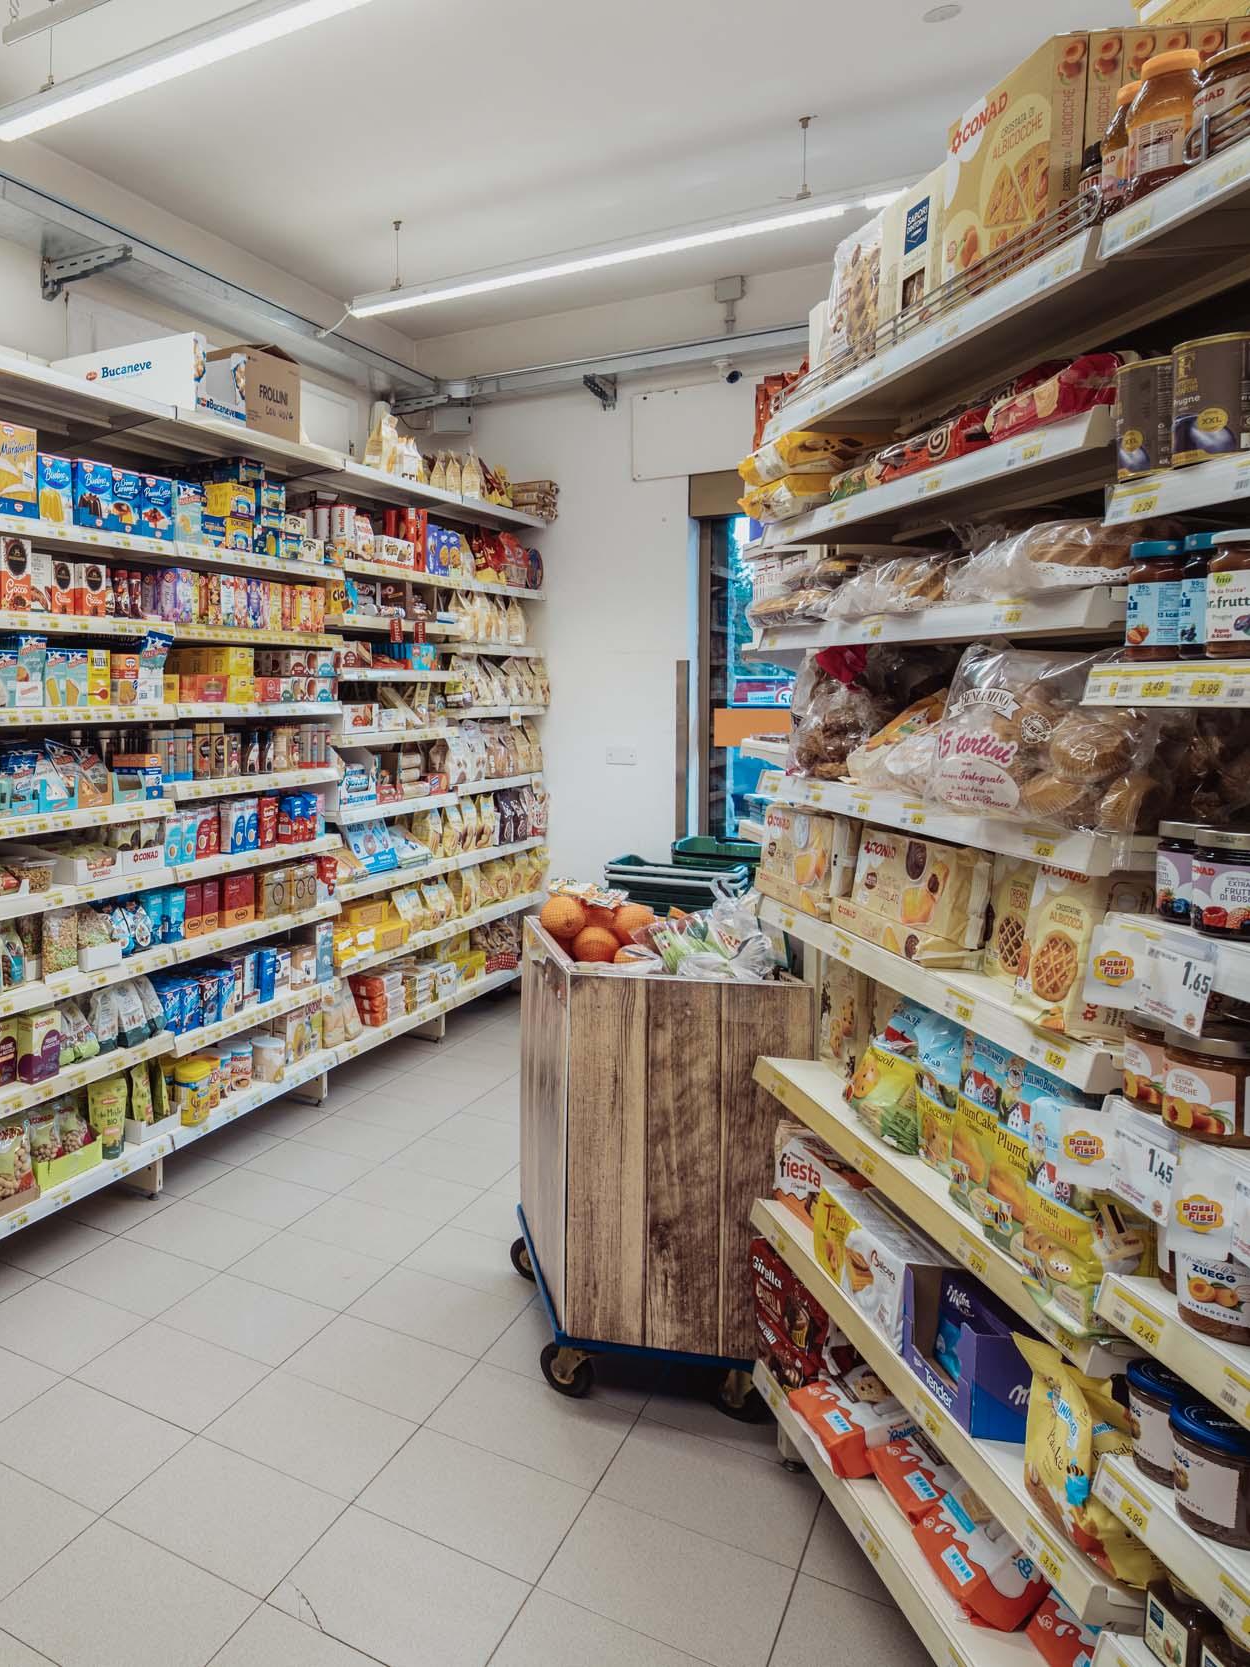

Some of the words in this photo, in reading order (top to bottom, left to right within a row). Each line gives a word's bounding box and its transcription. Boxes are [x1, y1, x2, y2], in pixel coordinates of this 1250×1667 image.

[962, 91, 1008, 142] CONAD
[1062, 88, 1075, 147] ALBICOCCHE
[992, 112, 1044, 161] ALBICOCCHE
[101, 360, 152, 379] Bucaneve
[259, 384, 289, 406] FROLLINI
[209, 399, 236, 418] Bucaneve
[1201, 416, 1222, 425] XXL
[1215, 575, 1233, 585] bio
[1198, 684, 1219, 694] 3,99
[956, 734, 1014, 763] tortini
[958, 771, 1005, 785] Integrale
[138, 851, 159, 861] CONAD
[1100, 959, 1127, 967] Bassi
[1103, 966, 1129, 976] Fissi
[1182, 961, 1211, 994] 1,65
[1171, 1083, 1198, 1096] PESCHE
[958, 1099, 998, 1134] PlumCake
[997, 1130, 1029, 1164] PlumC
[1069, 1138, 1096, 1147] Bassi
[1074, 1146, 1099, 1155] Fissi
[780, 1153, 821, 1189] fiesta
[1148, 1148, 1174, 1184] 1,45
[1040, 1198, 1059, 1218] Flauti
[1183, 1203, 1214, 1212] Bassi
[1188, 1212, 1217, 1222] Fissi
[752, 1255, 783, 1289] Girella
[1192, 1264, 1237, 1283] ZUEGG
[947, 1285, 971, 1308] Milka
[1137, 1325, 1156, 1343] 2,45
[924, 1368, 953, 1409] Tender
[1125, 1507, 1144, 1527] 2,99
